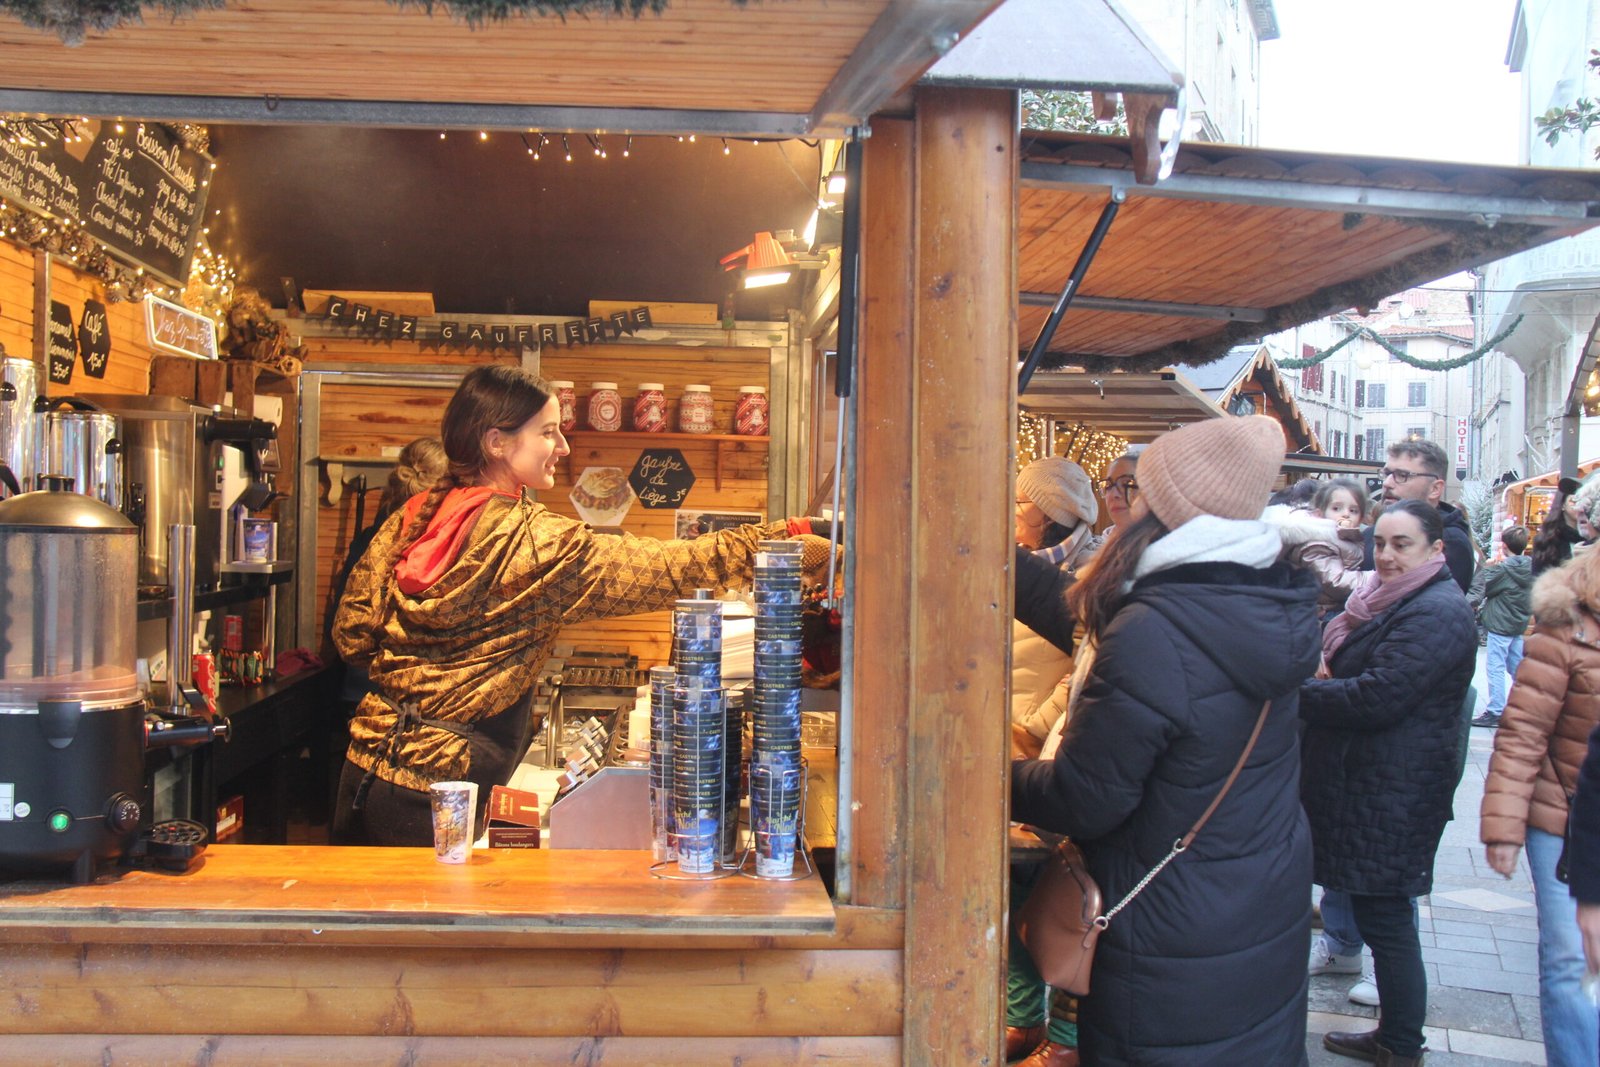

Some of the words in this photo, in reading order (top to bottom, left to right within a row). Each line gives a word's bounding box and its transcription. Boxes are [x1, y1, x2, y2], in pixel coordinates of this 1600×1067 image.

[84, 311, 104, 344] Café
[330, 303, 411, 333] CHEZ
[442, 312, 646, 342] GAUFRETTE
[1457, 419, 1467, 462] HOTEL
[639, 486, 667, 506] Liège
[650, 474, 668, 485] de
